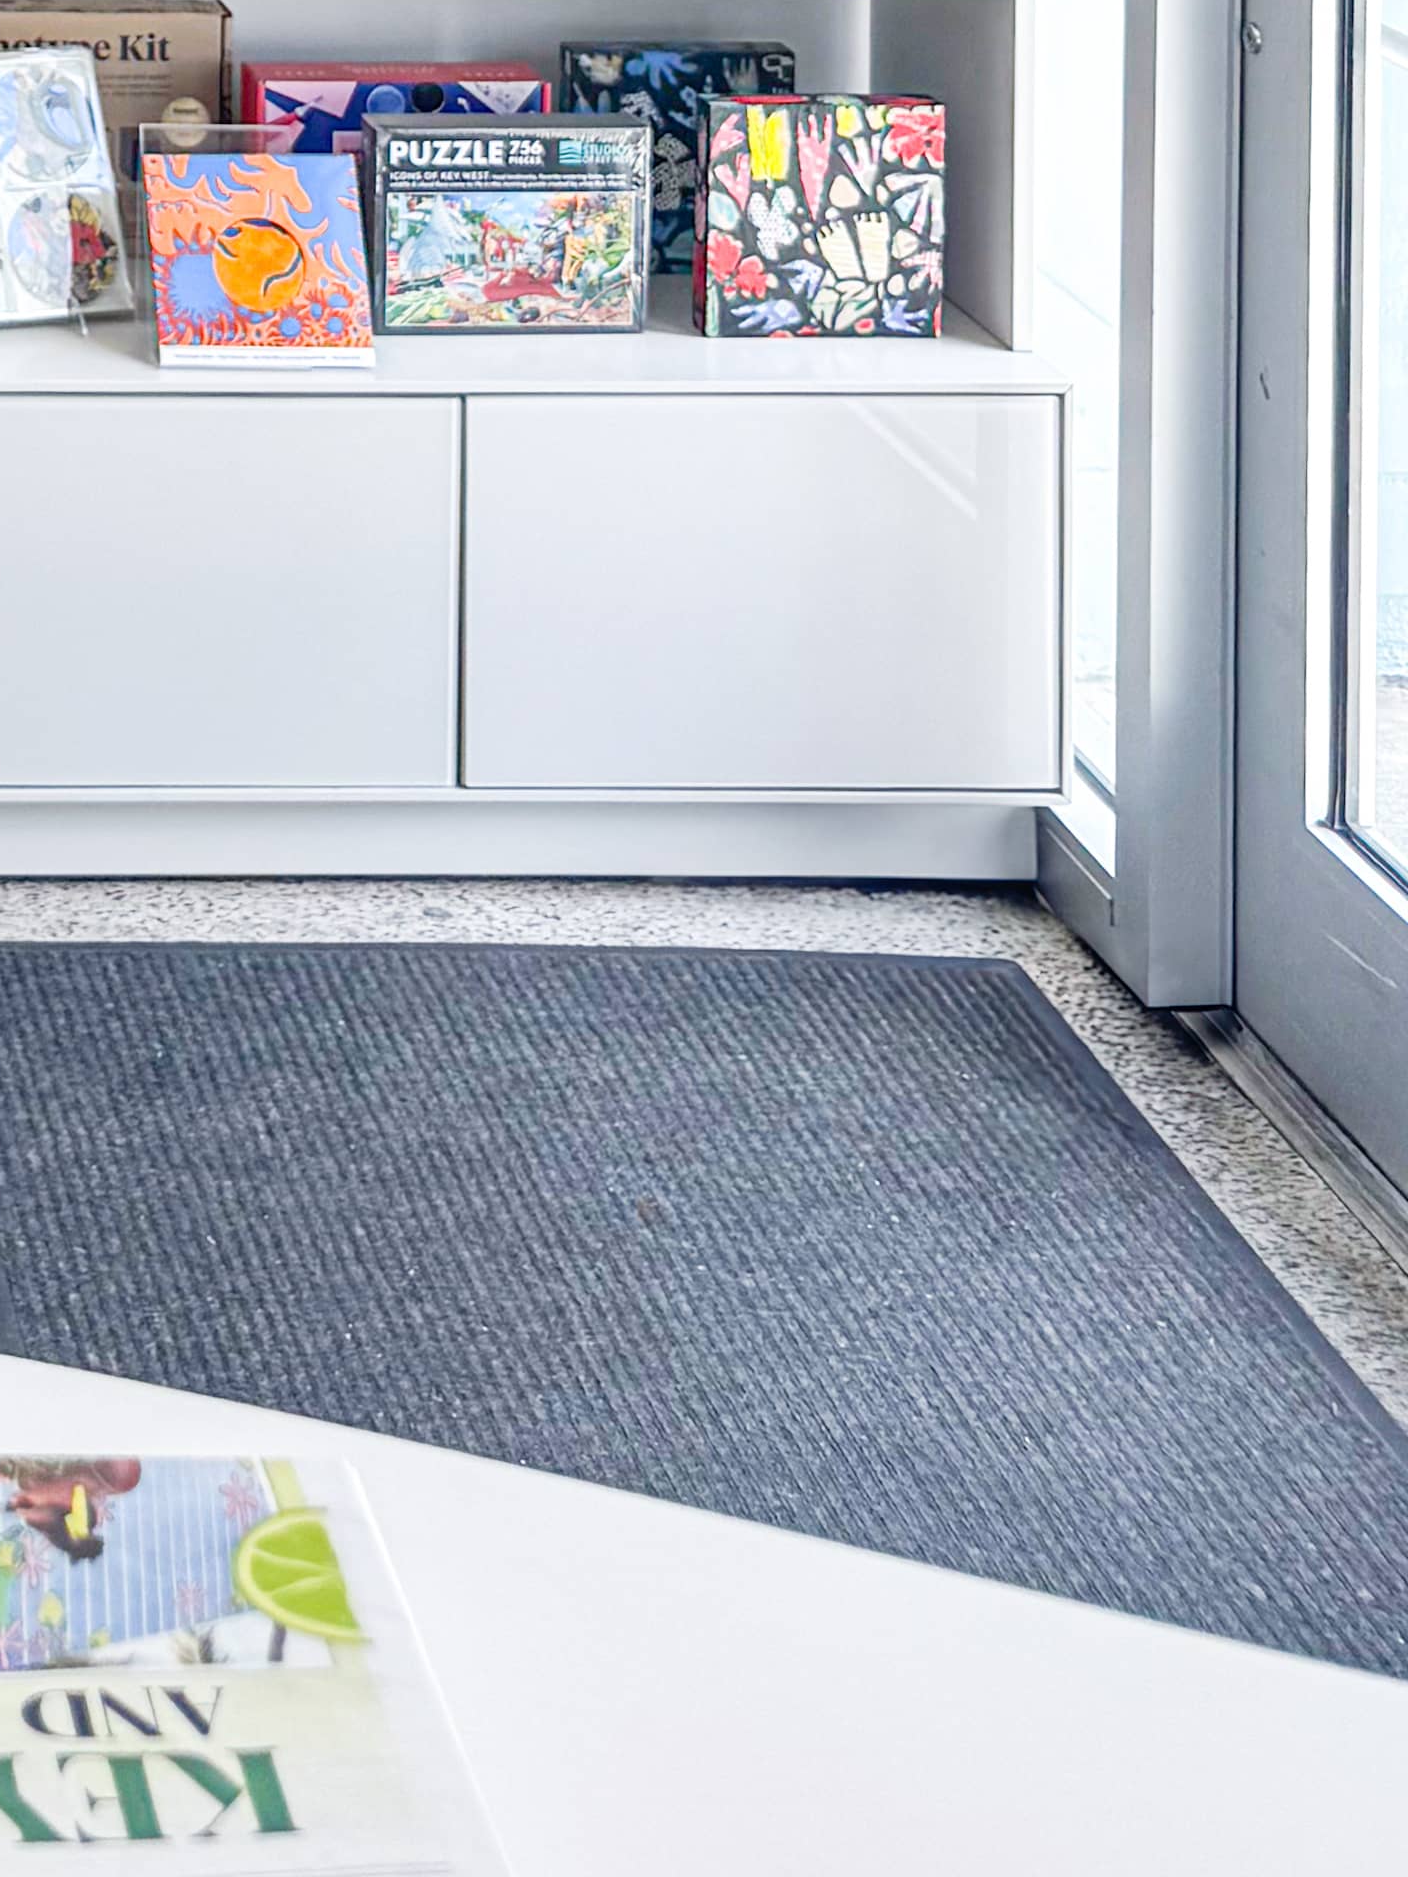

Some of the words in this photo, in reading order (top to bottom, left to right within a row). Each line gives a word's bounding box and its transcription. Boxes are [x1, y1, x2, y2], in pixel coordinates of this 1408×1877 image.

[119, 33, 171, 62] Kit
[390, 140, 505, 166] PUZZLE
[508, 141, 542, 155] 756
[508, 156, 543, 166] PIECES
[390, 172, 421, 181] ICONS
[424, 172, 438, 181] OF
[21, 1685, 224, 1741] AND
